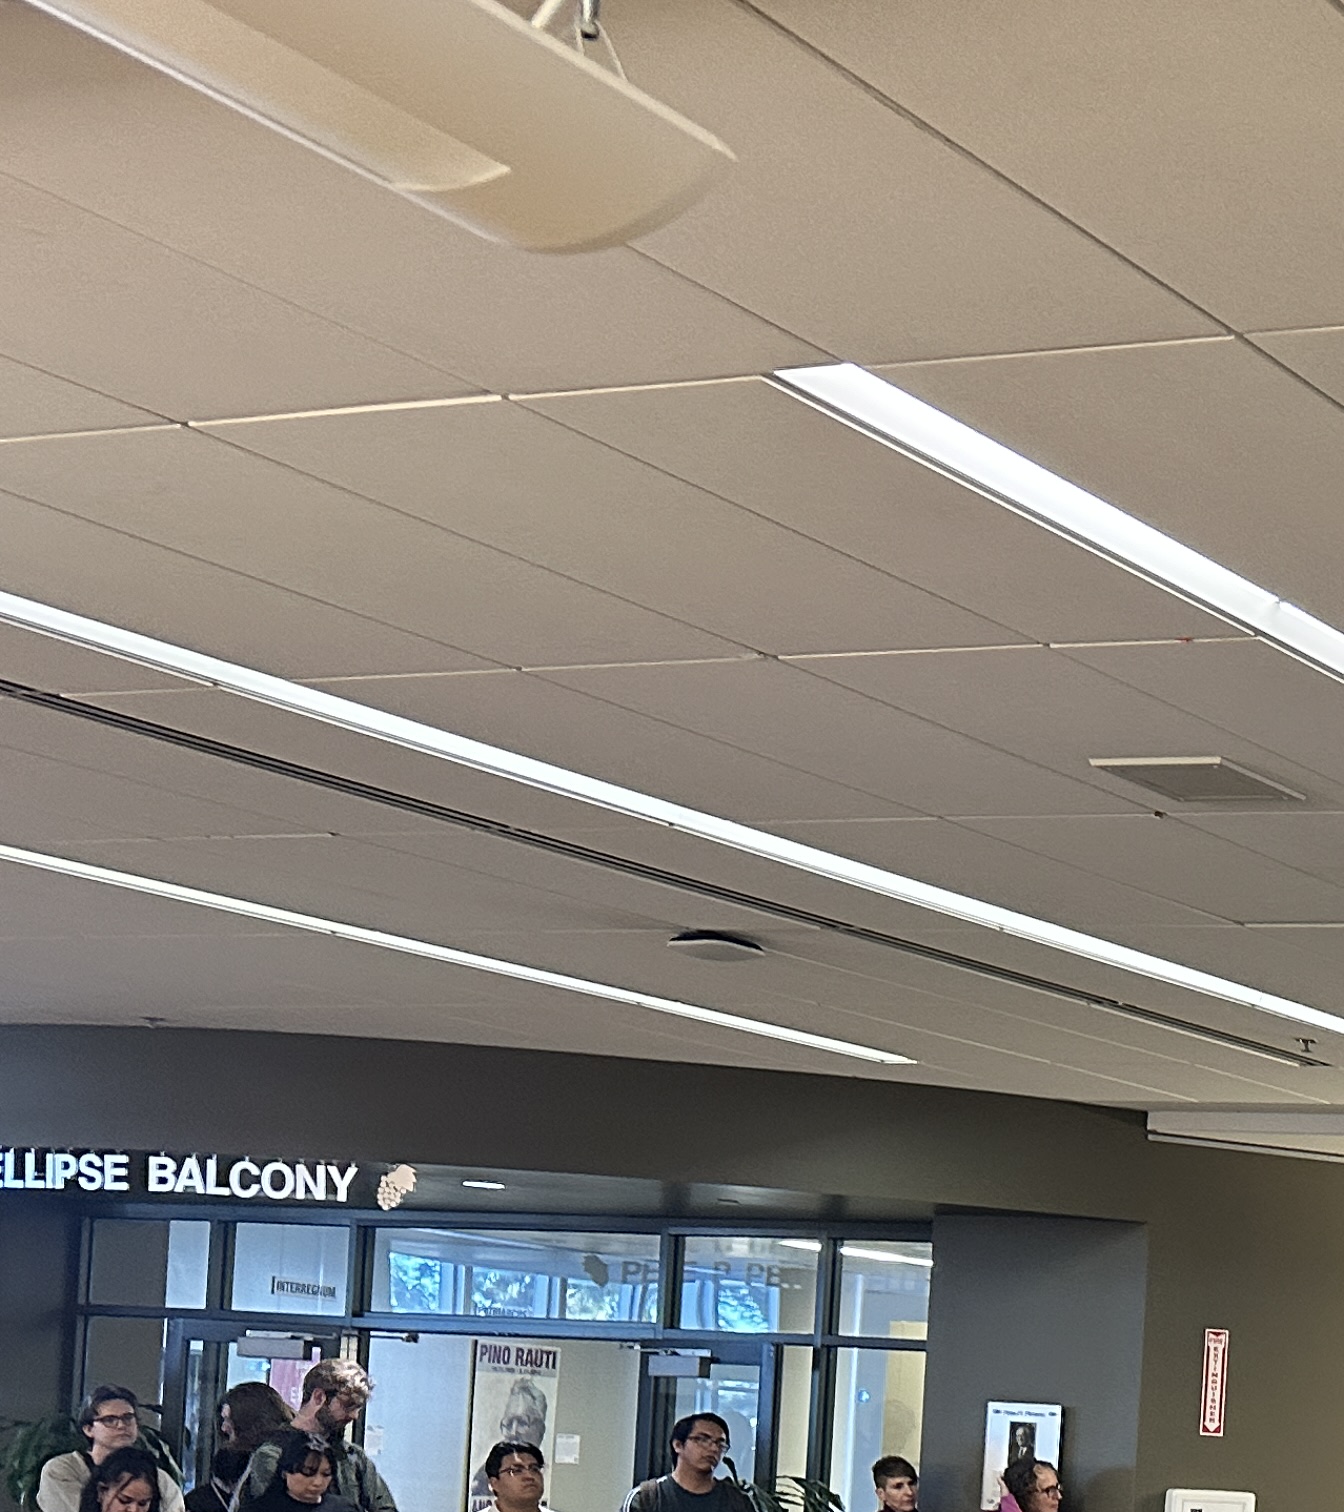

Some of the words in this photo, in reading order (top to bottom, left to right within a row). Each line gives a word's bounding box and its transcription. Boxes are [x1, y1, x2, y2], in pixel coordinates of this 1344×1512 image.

[0, 1147, 129, 1191] LLIPSE
[148, 1155, 358, 1202] BALCONY
[479, 1344, 511, 1365] PINO
[515, 1348, 557, 1370] RAUTI
